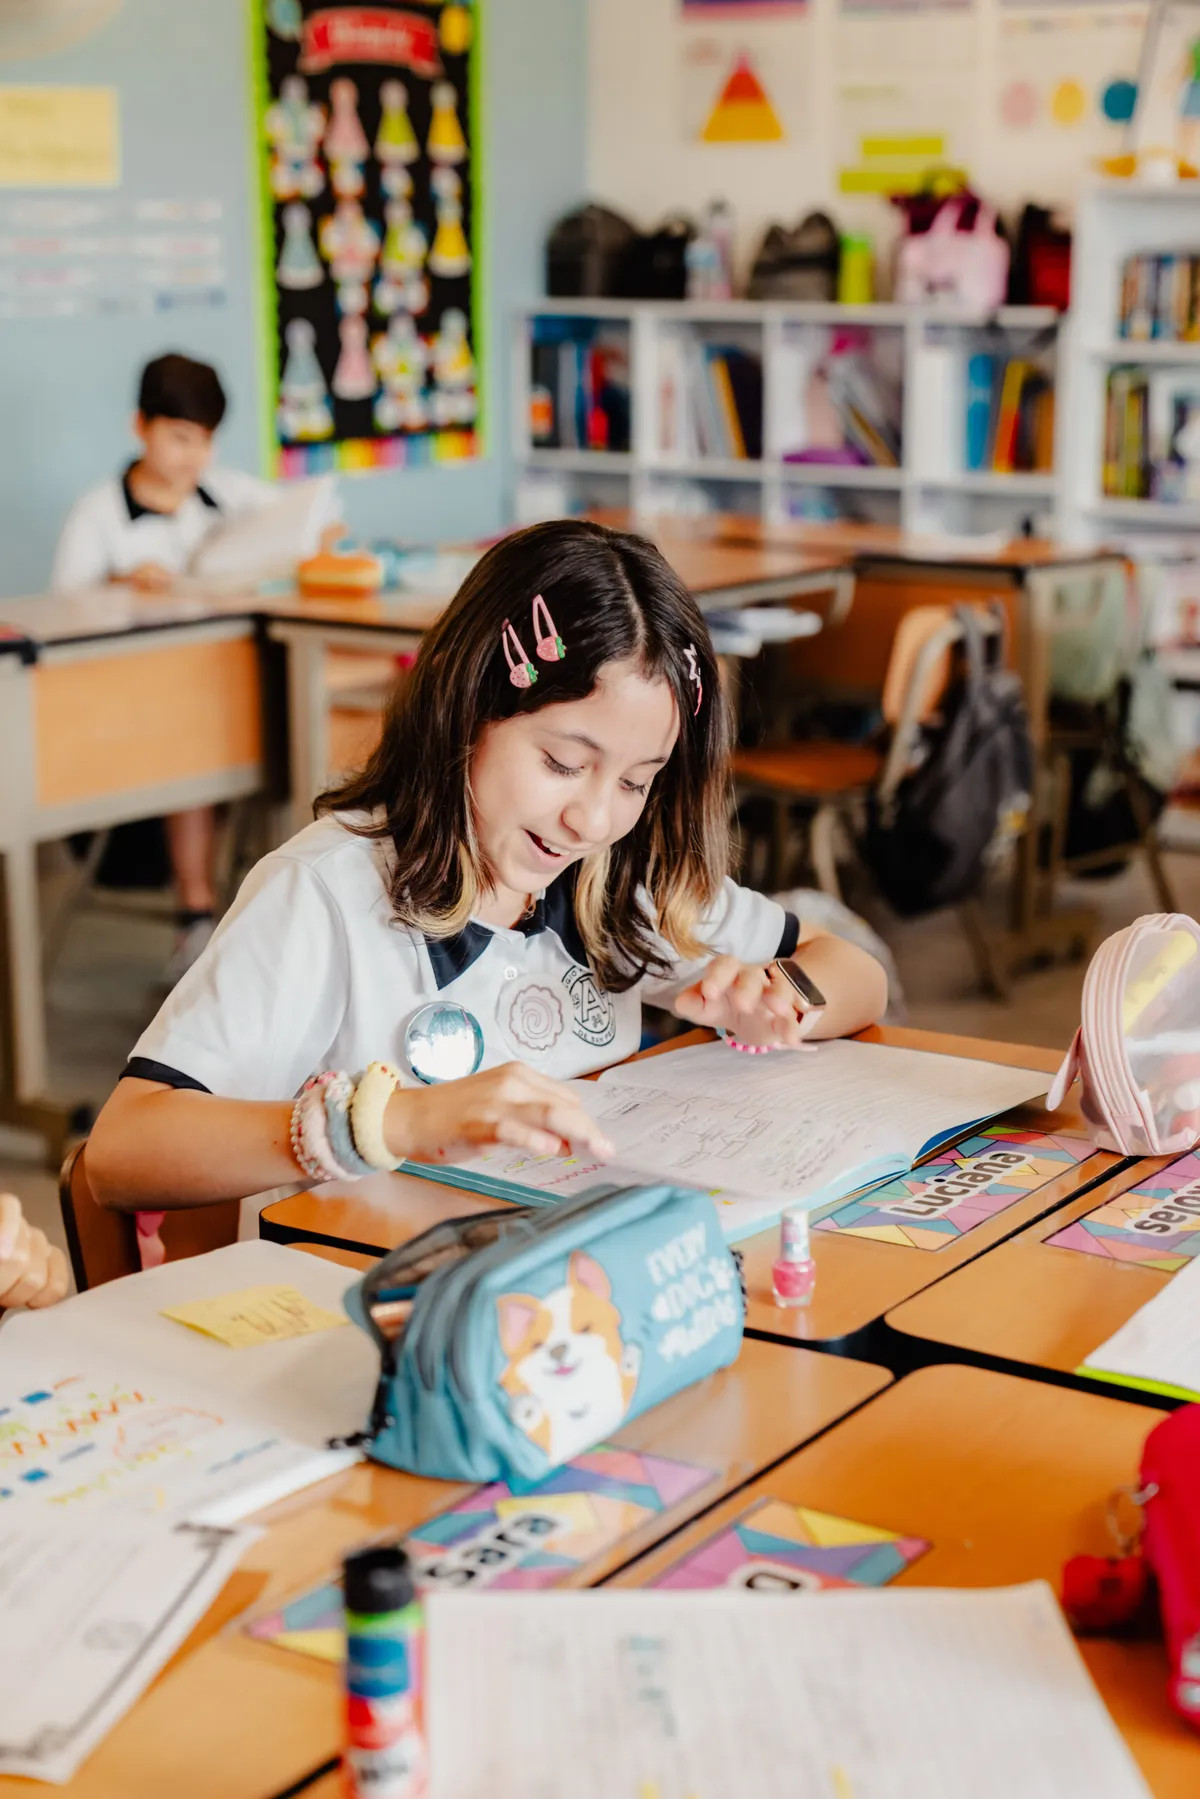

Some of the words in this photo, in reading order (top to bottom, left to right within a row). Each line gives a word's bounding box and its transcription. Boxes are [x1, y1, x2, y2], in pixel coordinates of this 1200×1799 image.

[579, 976, 607, 1023] A
[890, 1152, 1027, 1216] Luciana
[425, 1517, 556, 1587] Sara
